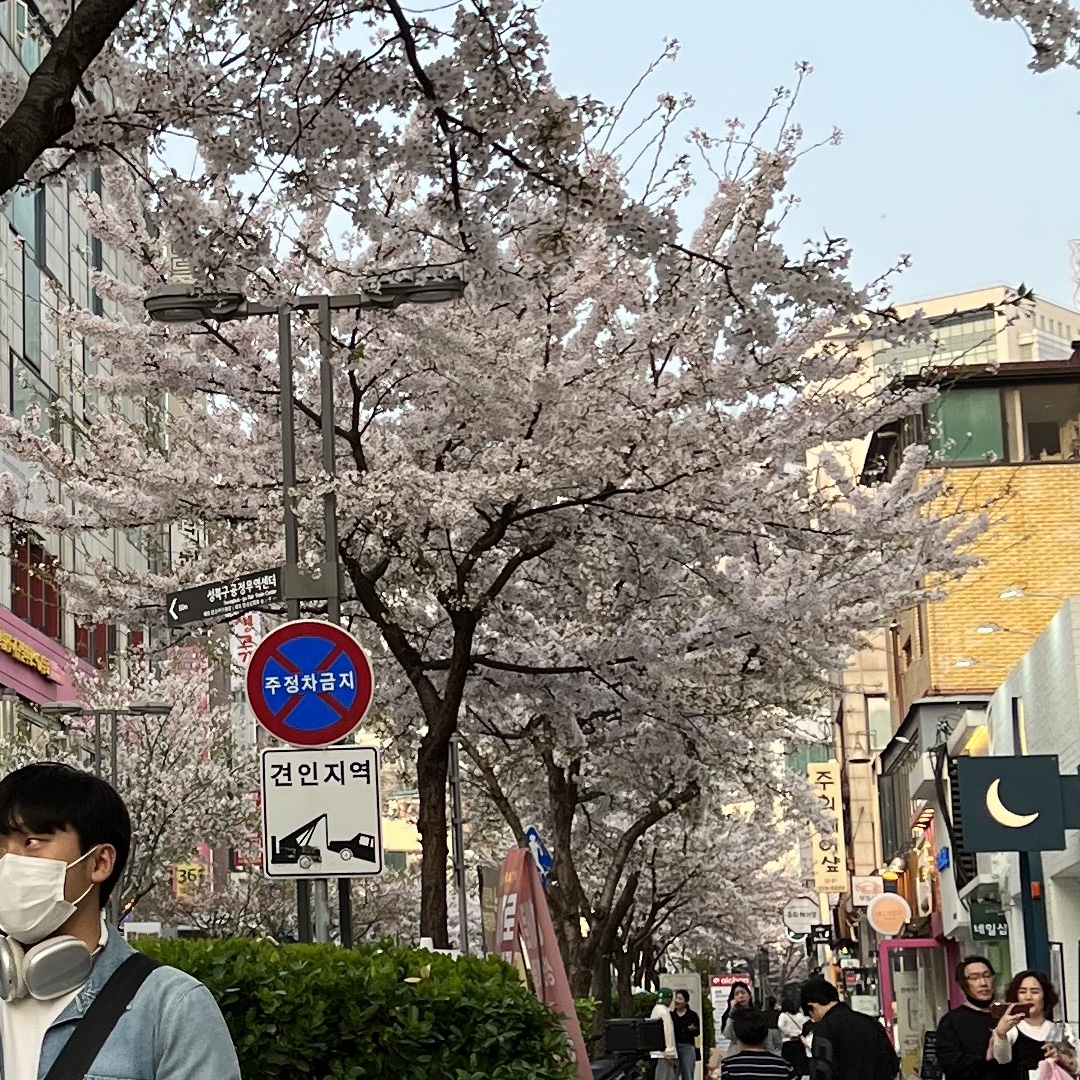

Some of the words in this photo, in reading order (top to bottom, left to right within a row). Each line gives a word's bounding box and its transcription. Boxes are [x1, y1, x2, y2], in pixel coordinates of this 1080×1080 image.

[207, 573, 277, 602] 성북구공정무역센터
[264, 672, 355, 695] 주정차금지
[270, 760, 372, 787] 견인지역
